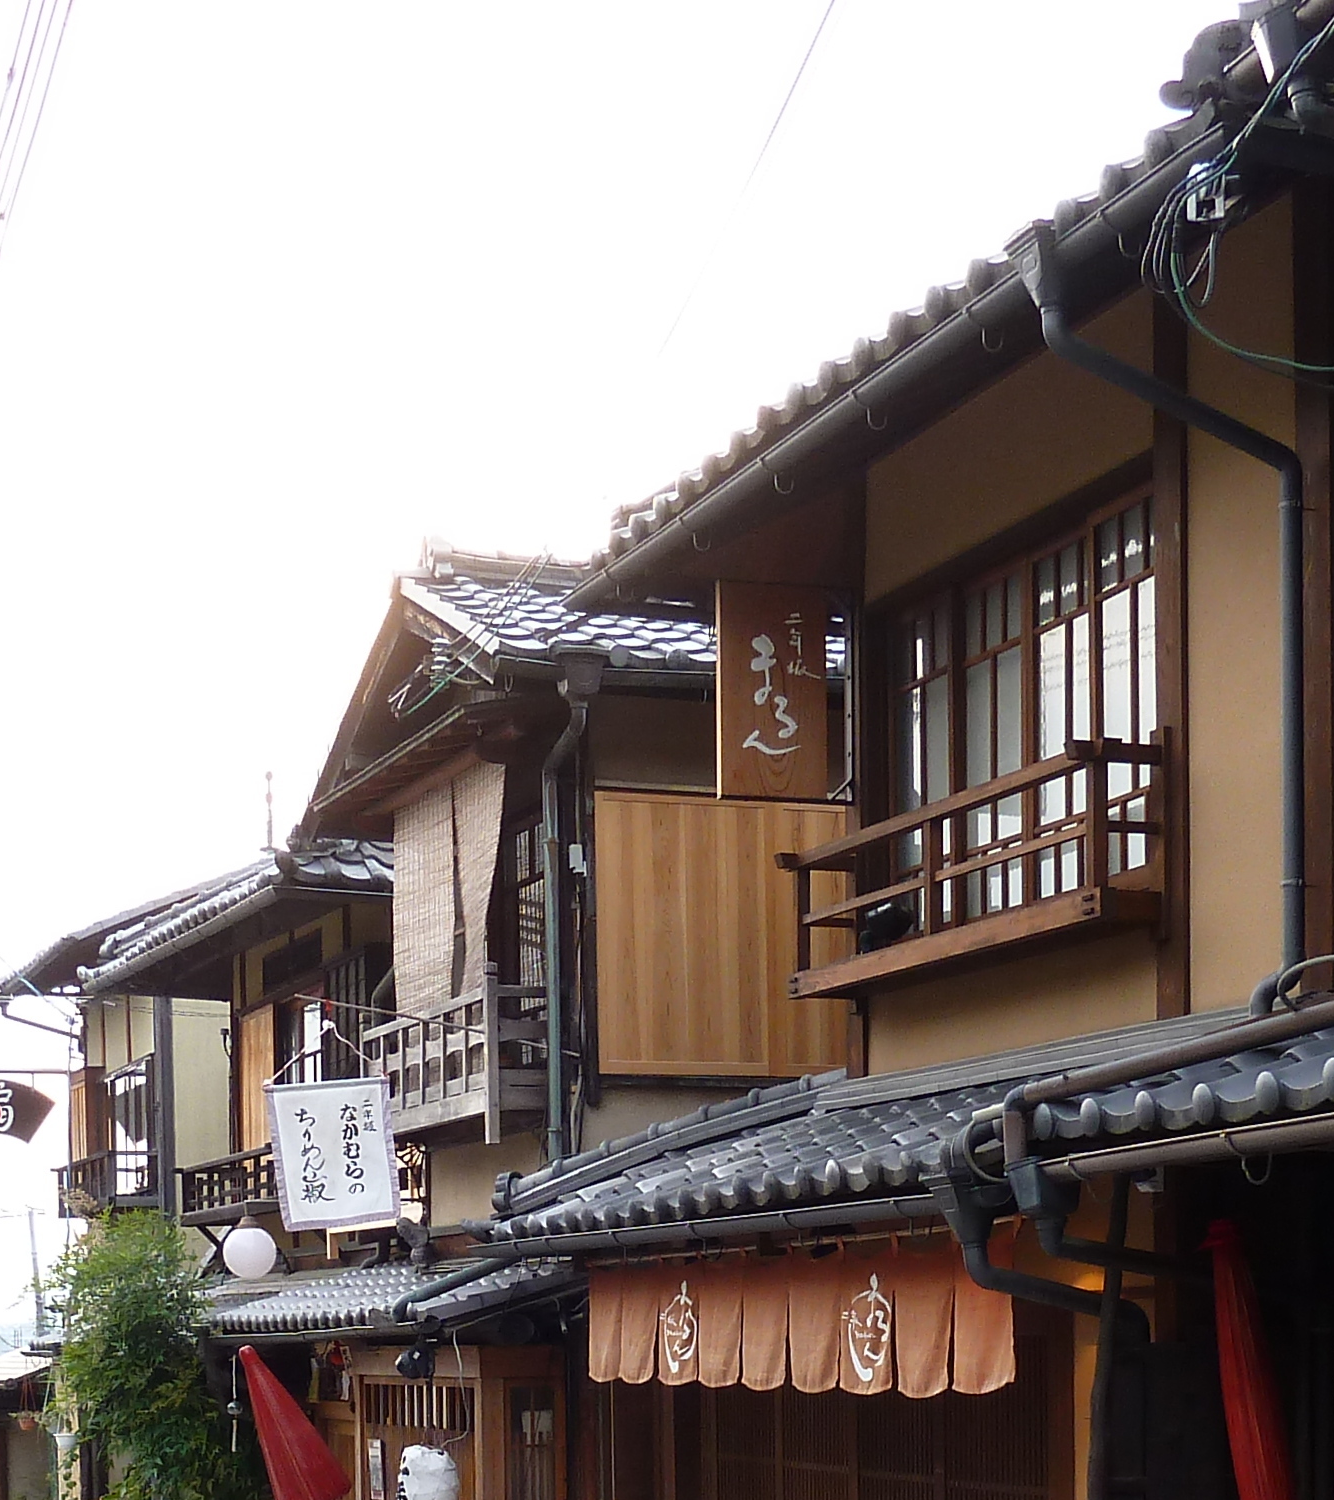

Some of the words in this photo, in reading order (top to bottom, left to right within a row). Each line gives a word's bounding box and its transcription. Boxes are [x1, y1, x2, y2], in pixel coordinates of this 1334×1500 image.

[339, 1103, 366, 1196] なかむらの
